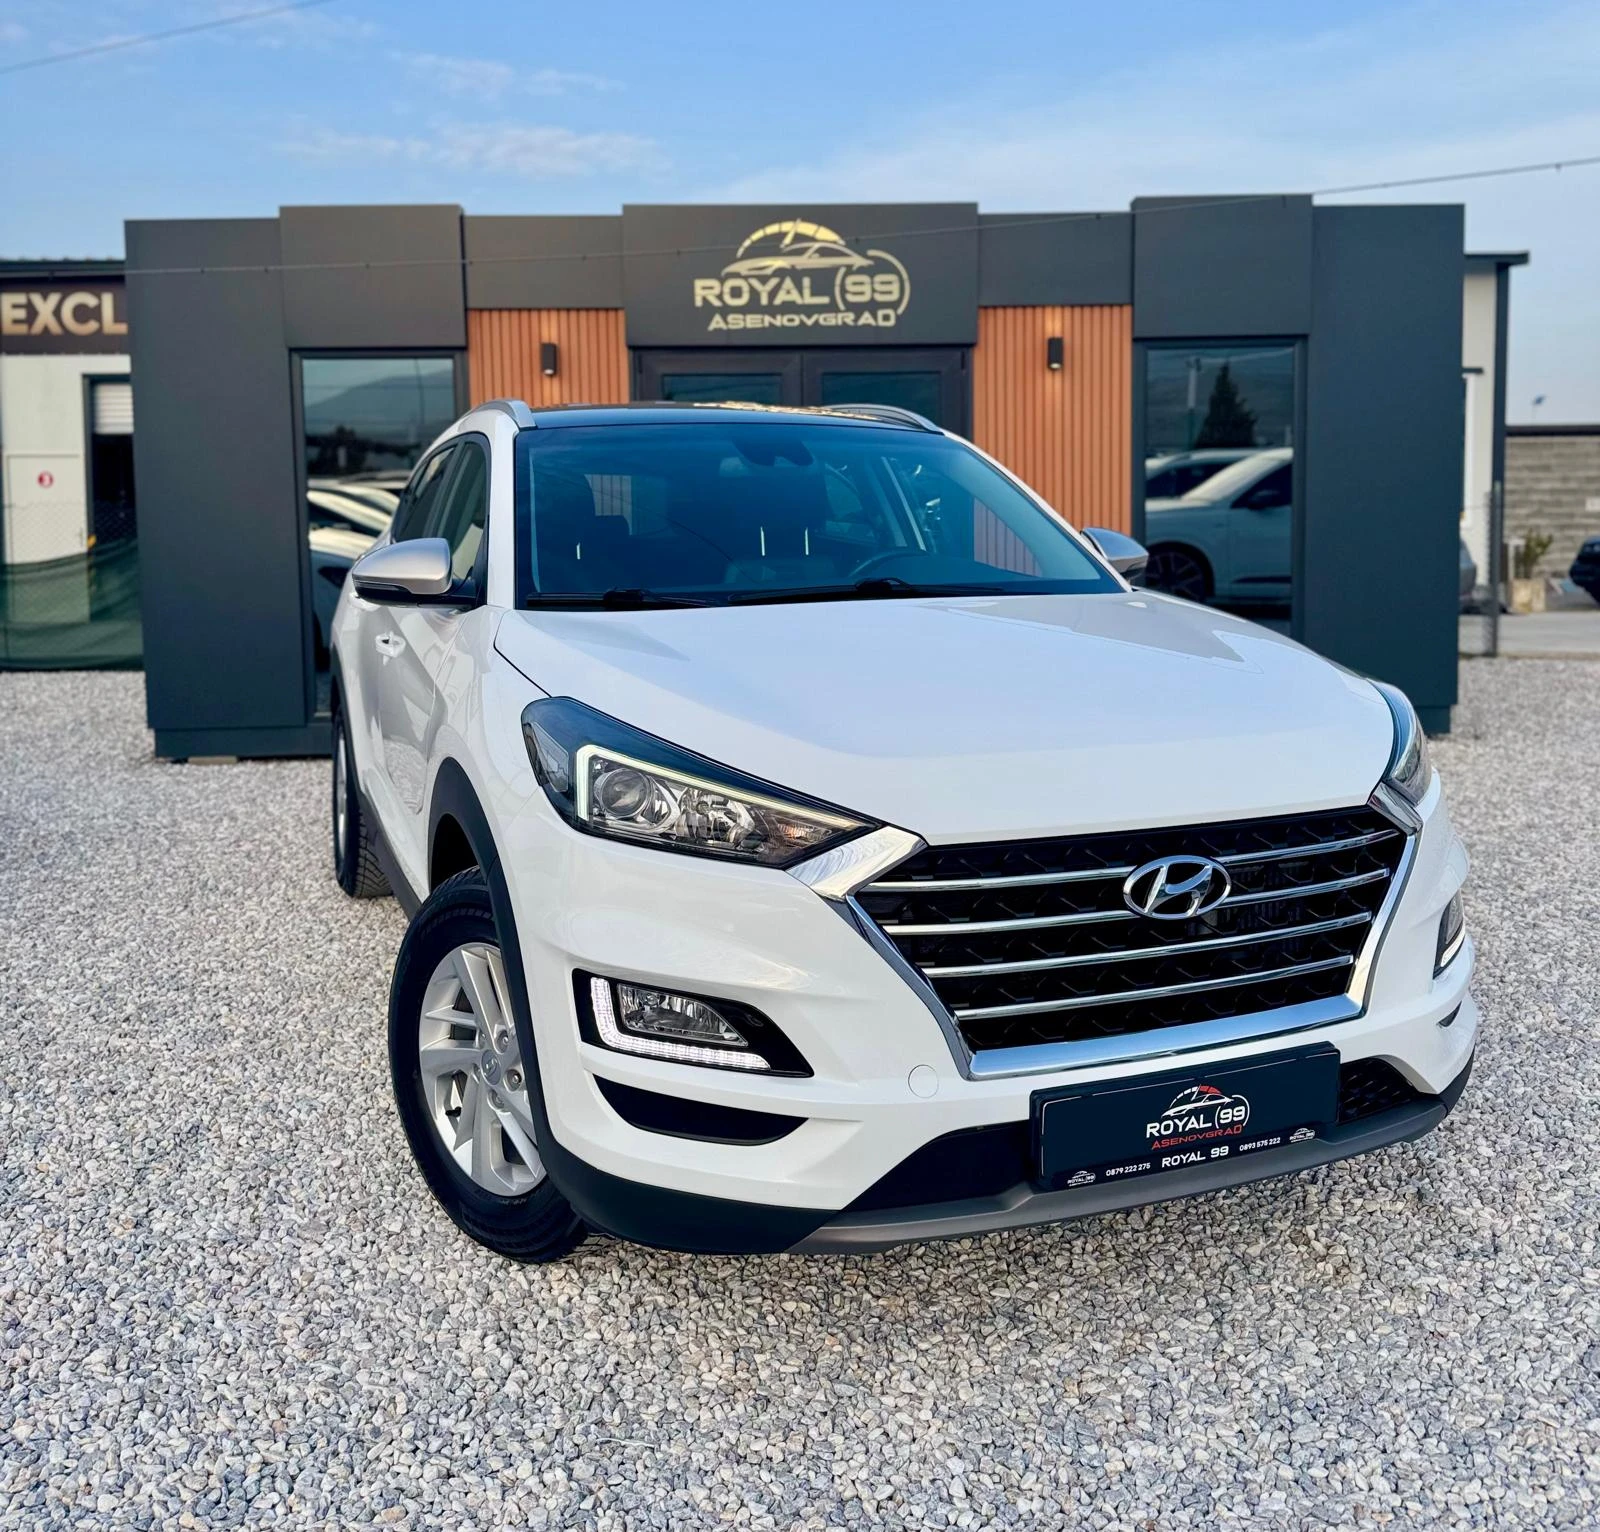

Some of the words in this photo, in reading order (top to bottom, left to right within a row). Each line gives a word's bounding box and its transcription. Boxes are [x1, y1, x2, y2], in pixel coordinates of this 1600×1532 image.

[694, 276, 830, 307] ROYAL
[1, 291, 128, 336] EXCL
[708, 308, 897, 331] ASENOVGRAD
[1146, 1114, 1212, 1138] ROYAL
[1151, 1124, 1243, 1150] ASENOVGRAD
[1239, 1142, 1256, 1151] 0893
[1268, 1137, 1281, 1145] 222
[1161, 1151, 1206, 1168] ROYAL
[1210, 1145, 1229, 1158] 99
[1105, 1167, 1124, 1176] 0879
[1124, 1165, 1137, 1173] 222
[1138, 1162, 1151, 1171] 275
